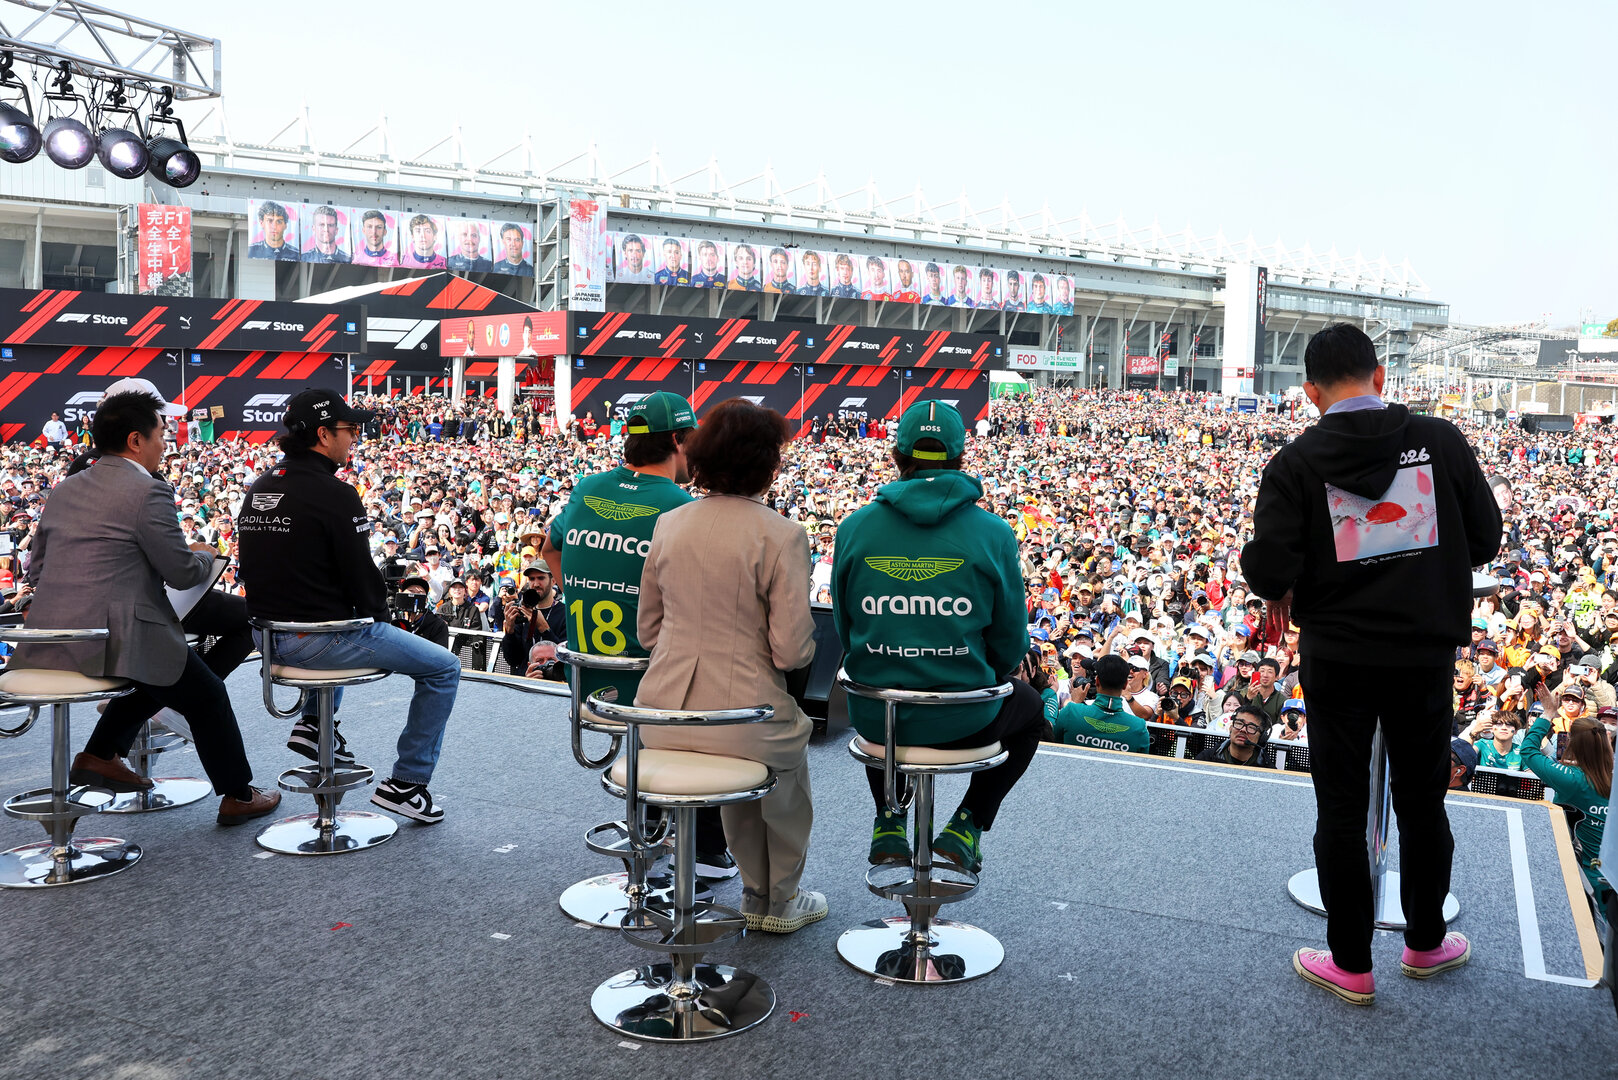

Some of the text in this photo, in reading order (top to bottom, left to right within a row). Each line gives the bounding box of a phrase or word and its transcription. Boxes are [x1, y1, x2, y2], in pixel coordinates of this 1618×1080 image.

[92, 314, 128, 325] Store
[273, 322, 304, 332] Store
[638, 331, 662, 340] Store
[756, 336, 777, 346] Store
[861, 342, 880, 350] Store
[955, 347, 972, 355] Store
[1016, 354, 1037, 365] FOD
[838, 410, 868, 420] Store
[618, 482, 638, 490] BOSS
[616, 505, 634, 513] MARTIN
[240, 516, 292, 525] CADILLAC
[566, 528, 652, 558] aramco
[574, 577, 640, 594] Honda
[862, 596, 972, 616] aramco
[570, 599, 626, 655] 18
[886, 646, 969, 658] Honda
[1076, 734, 1130, 752] aramco
